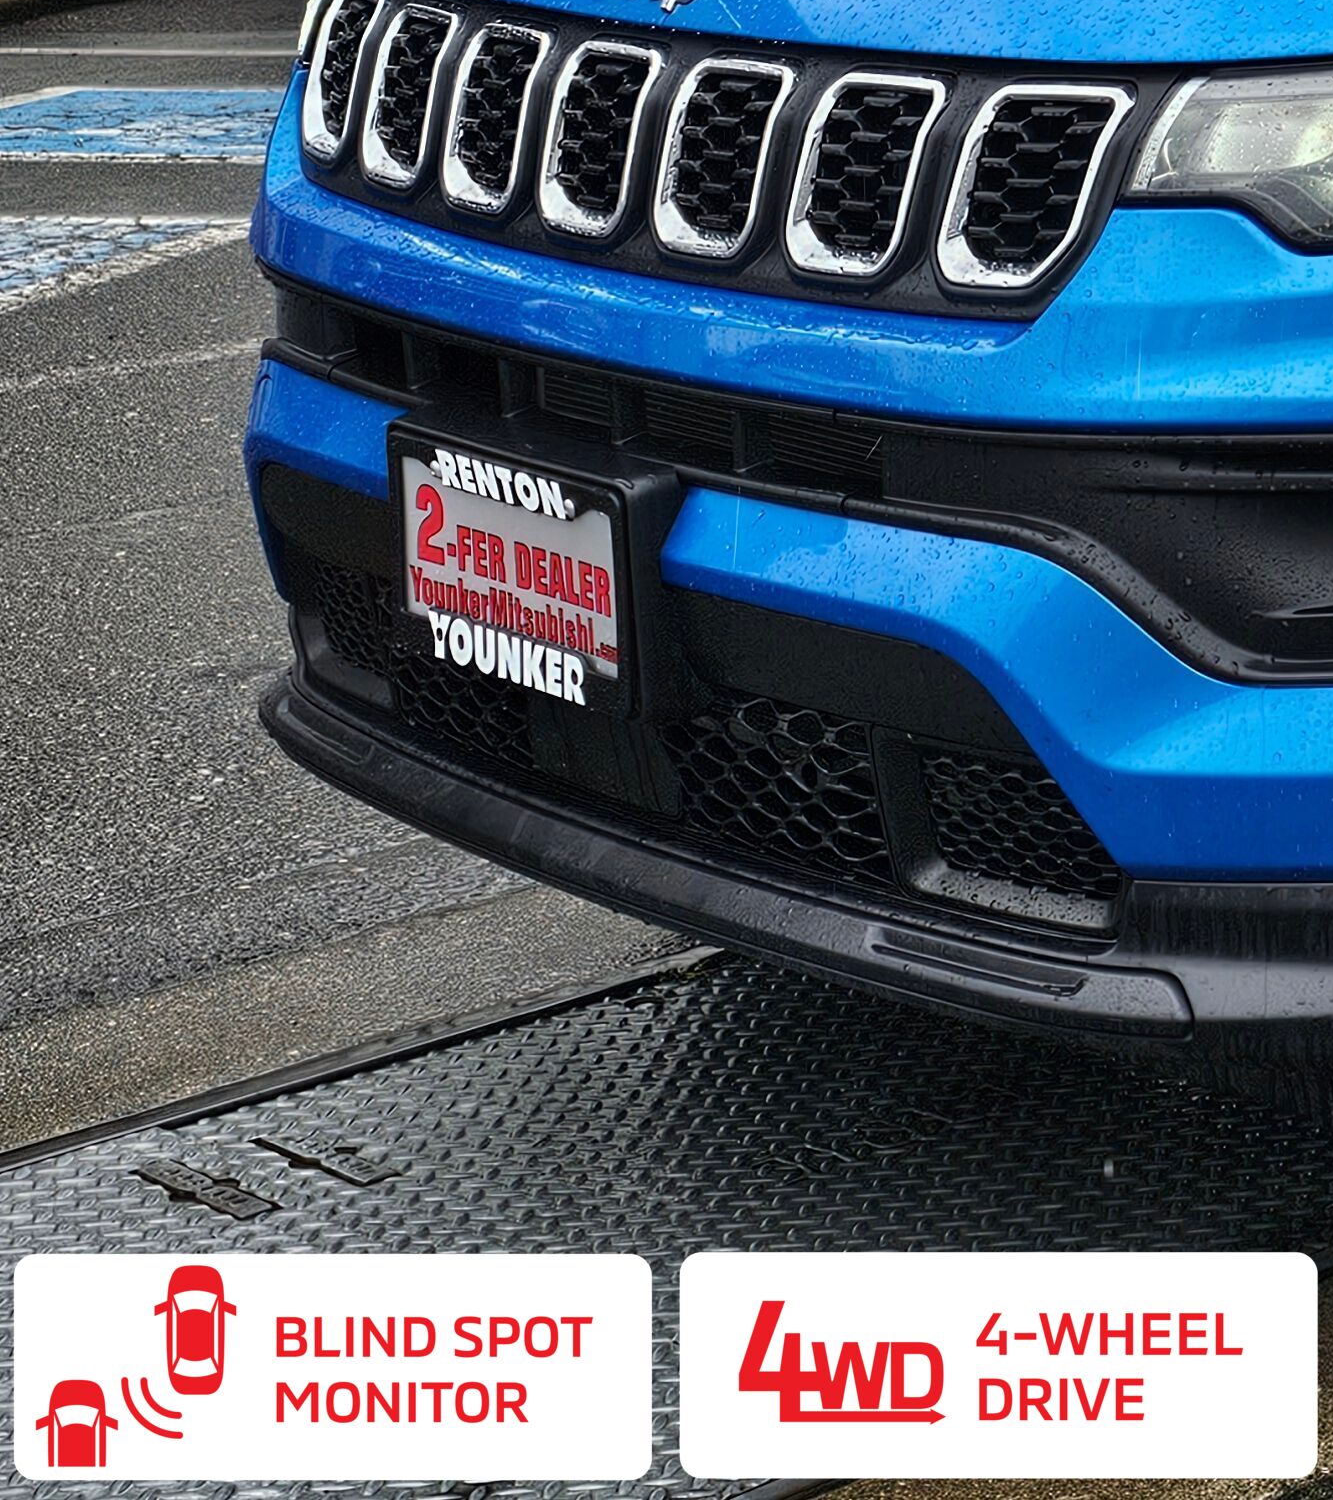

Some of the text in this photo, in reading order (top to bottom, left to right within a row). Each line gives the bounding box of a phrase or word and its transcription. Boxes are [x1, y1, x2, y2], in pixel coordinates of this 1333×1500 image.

[435, 449, 567, 520] RENTON
[415, 484, 612, 617] 2-FER DEALER
[428, 608, 586, 706] YOUNKER
